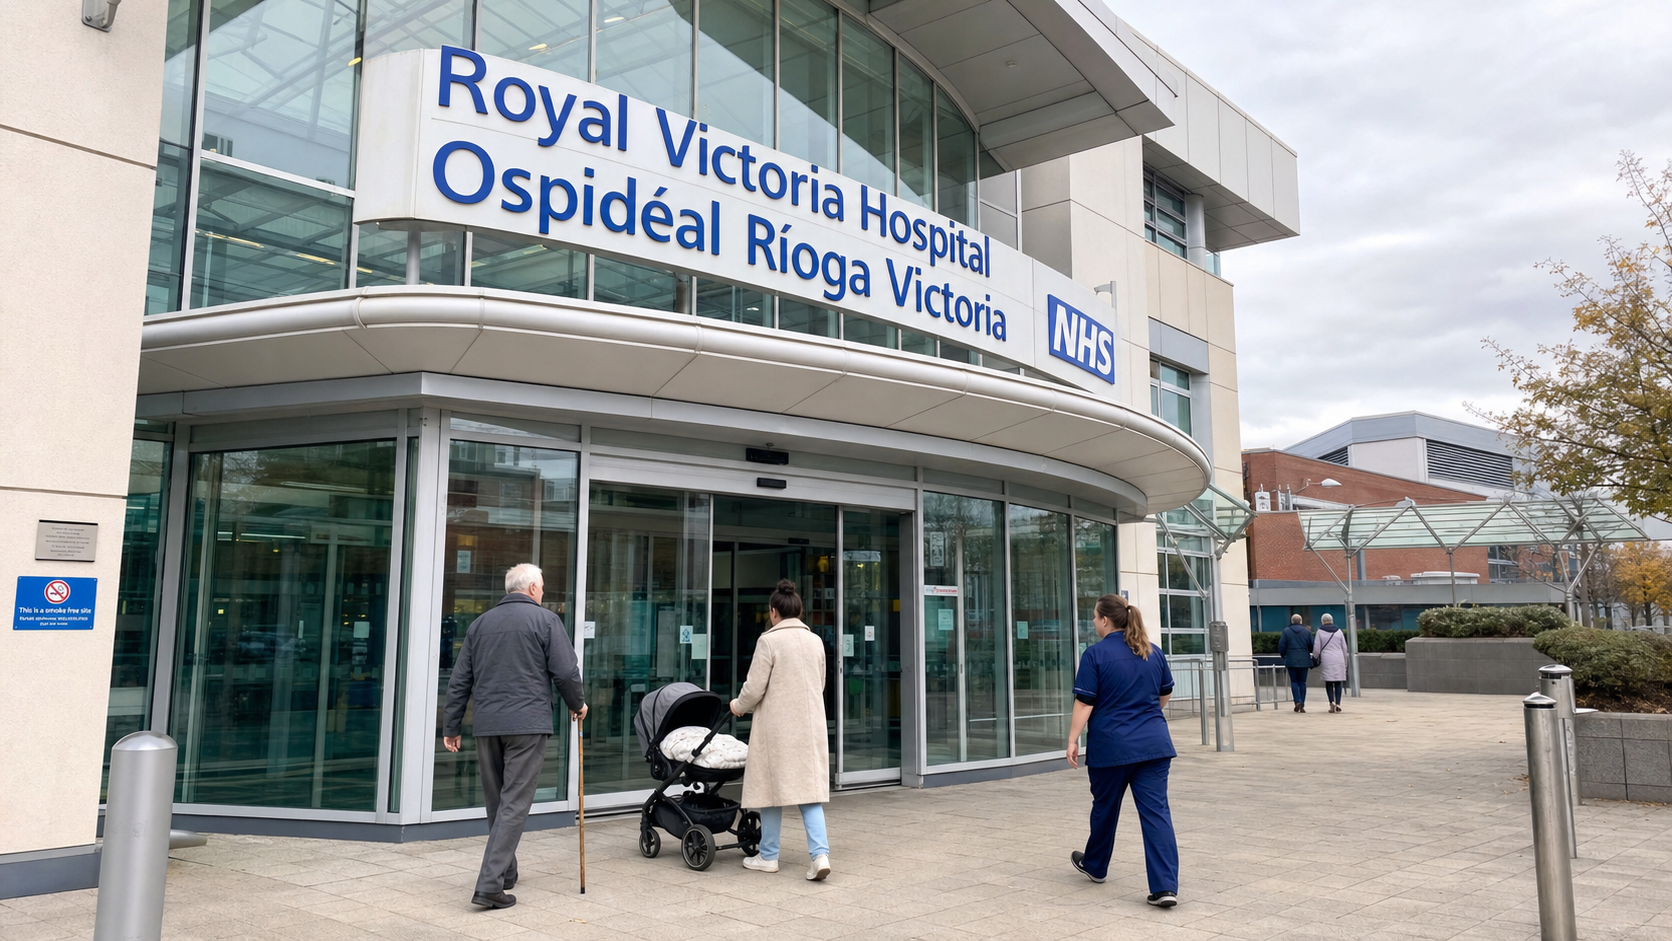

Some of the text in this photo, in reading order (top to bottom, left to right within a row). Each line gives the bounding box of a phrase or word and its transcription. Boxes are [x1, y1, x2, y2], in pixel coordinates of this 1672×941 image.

[432, 140, 1007, 341] Ospidéal Ríoga Victoria
[438, 44, 990, 277] Royal Victoria Hospital
[1053, 303, 1113, 376] NHS
